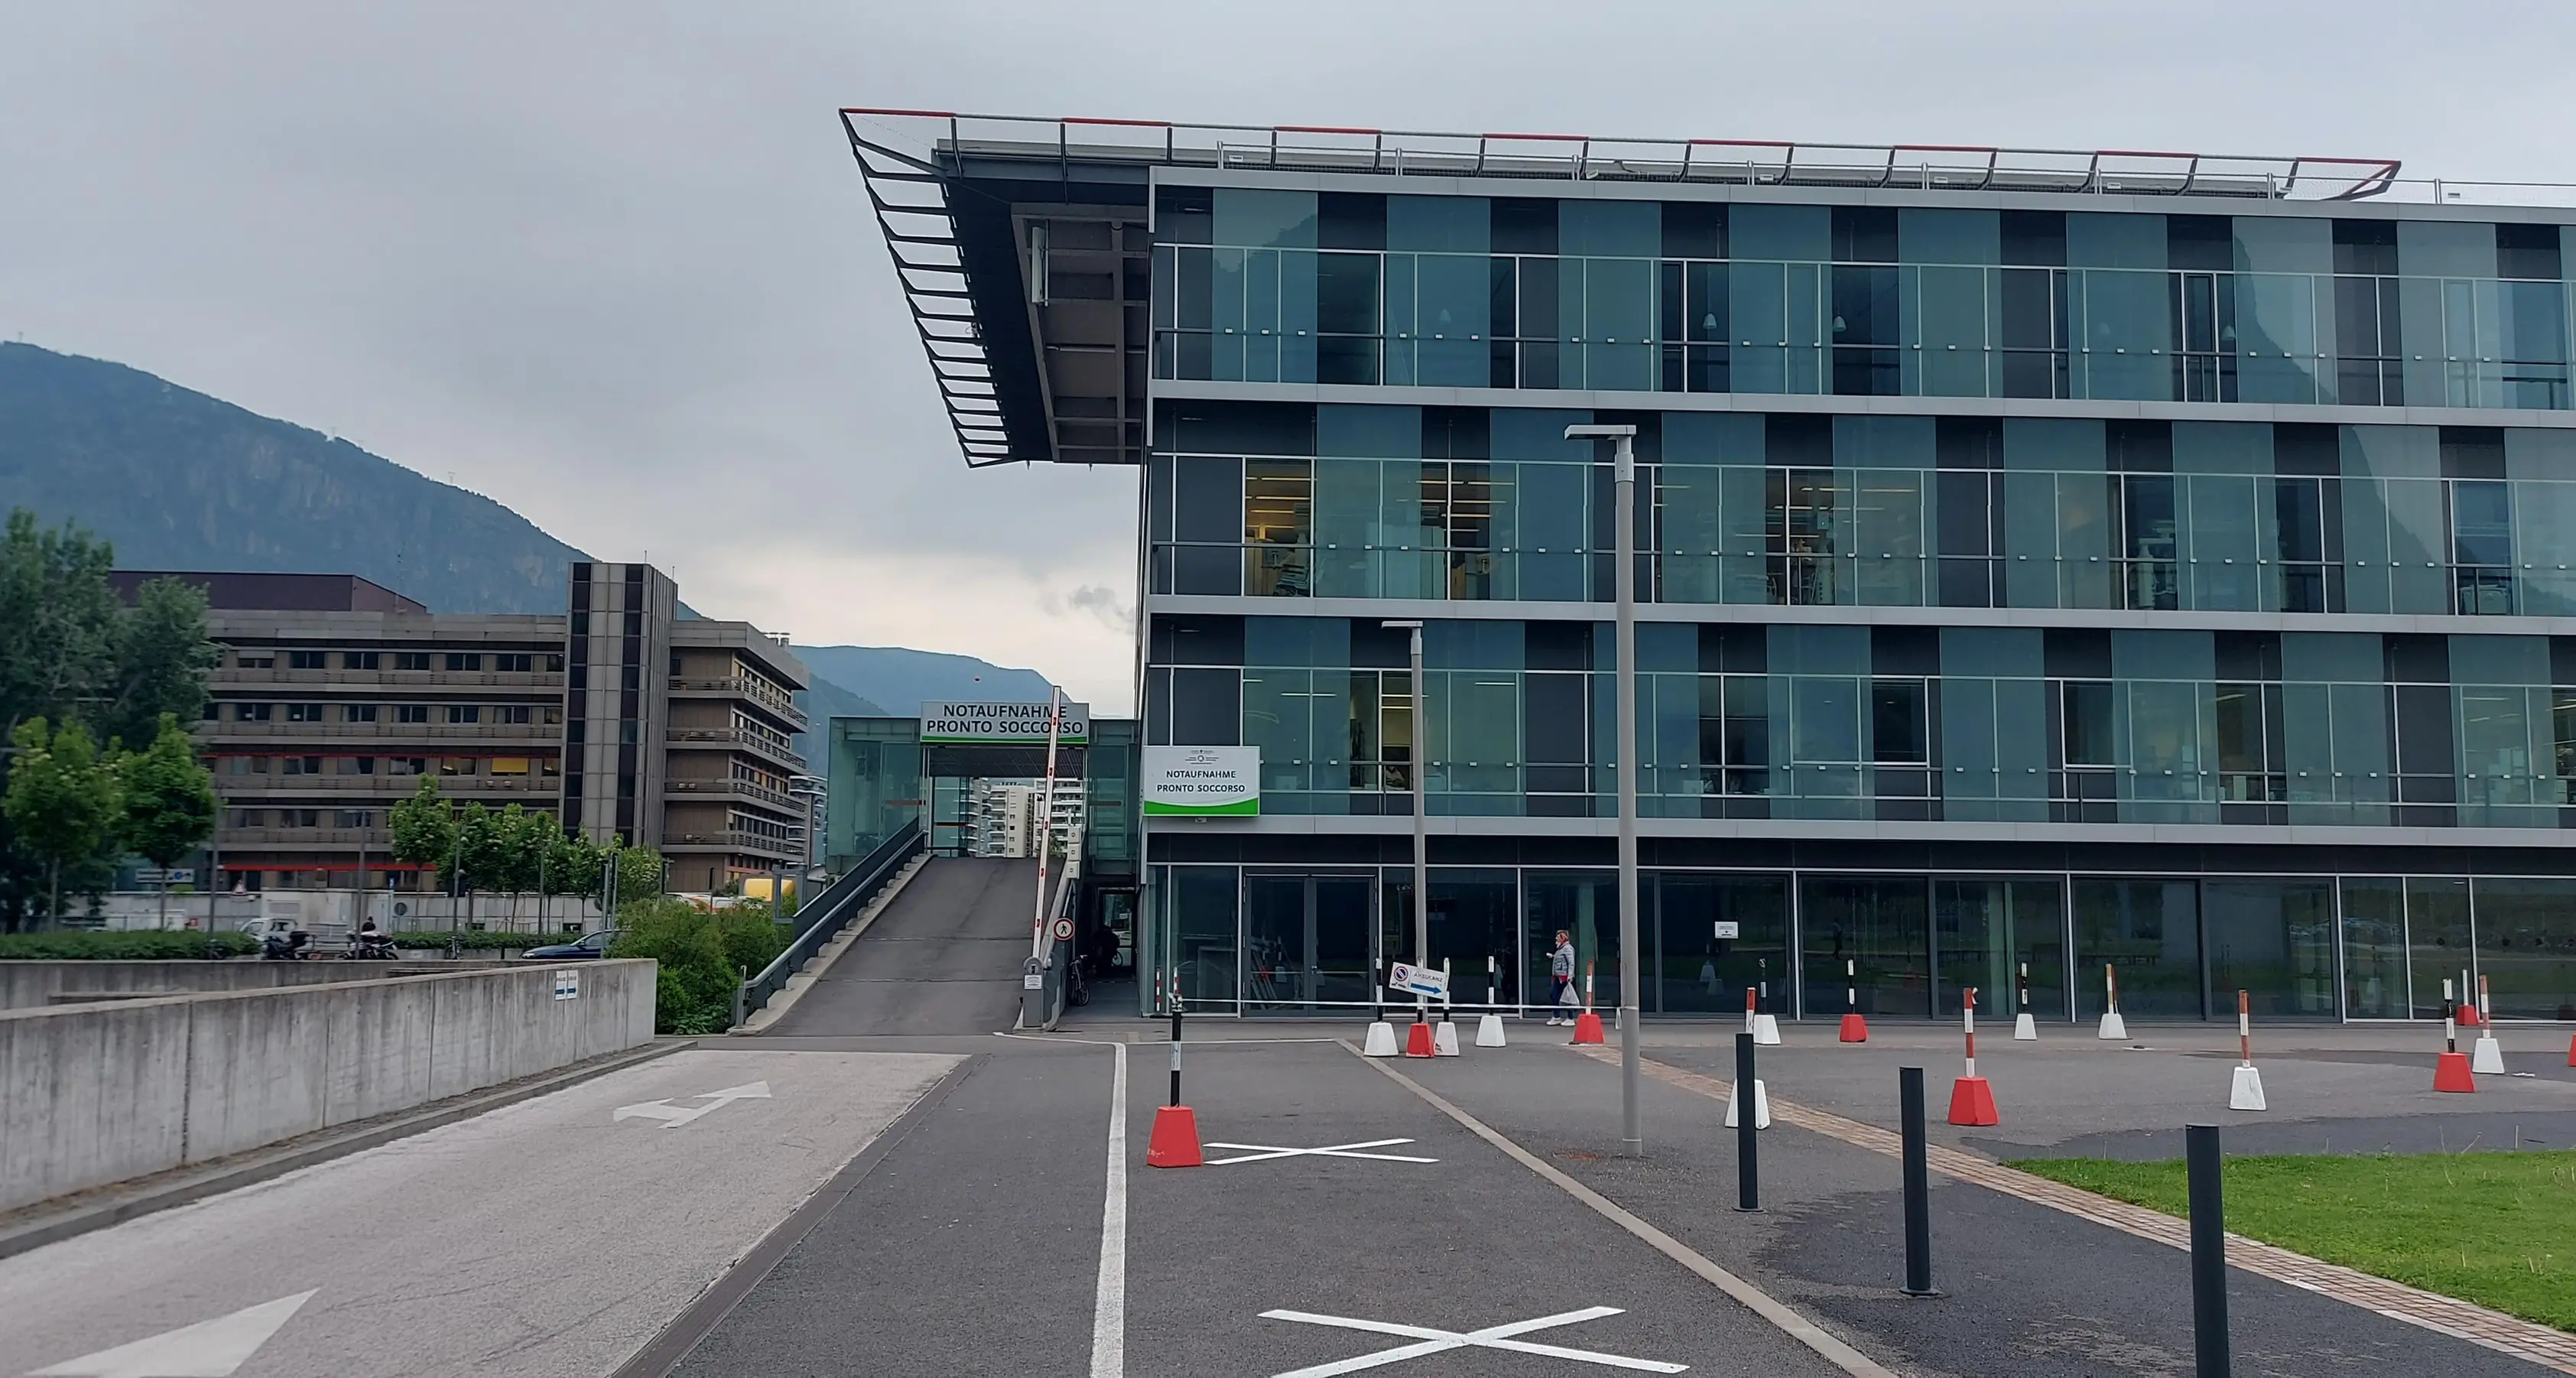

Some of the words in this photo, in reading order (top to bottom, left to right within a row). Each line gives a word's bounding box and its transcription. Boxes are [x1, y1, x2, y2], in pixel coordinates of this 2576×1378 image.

[944, 704, 1067, 718] NOTAUFNAHME
[927, 720, 992, 733] PRONTO
[1166, 770, 1236, 778] NOTAUFNAHME
[1157, 784, 1194, 792] PRONTO
[1197, 784, 1246, 792] SOCCORSO
